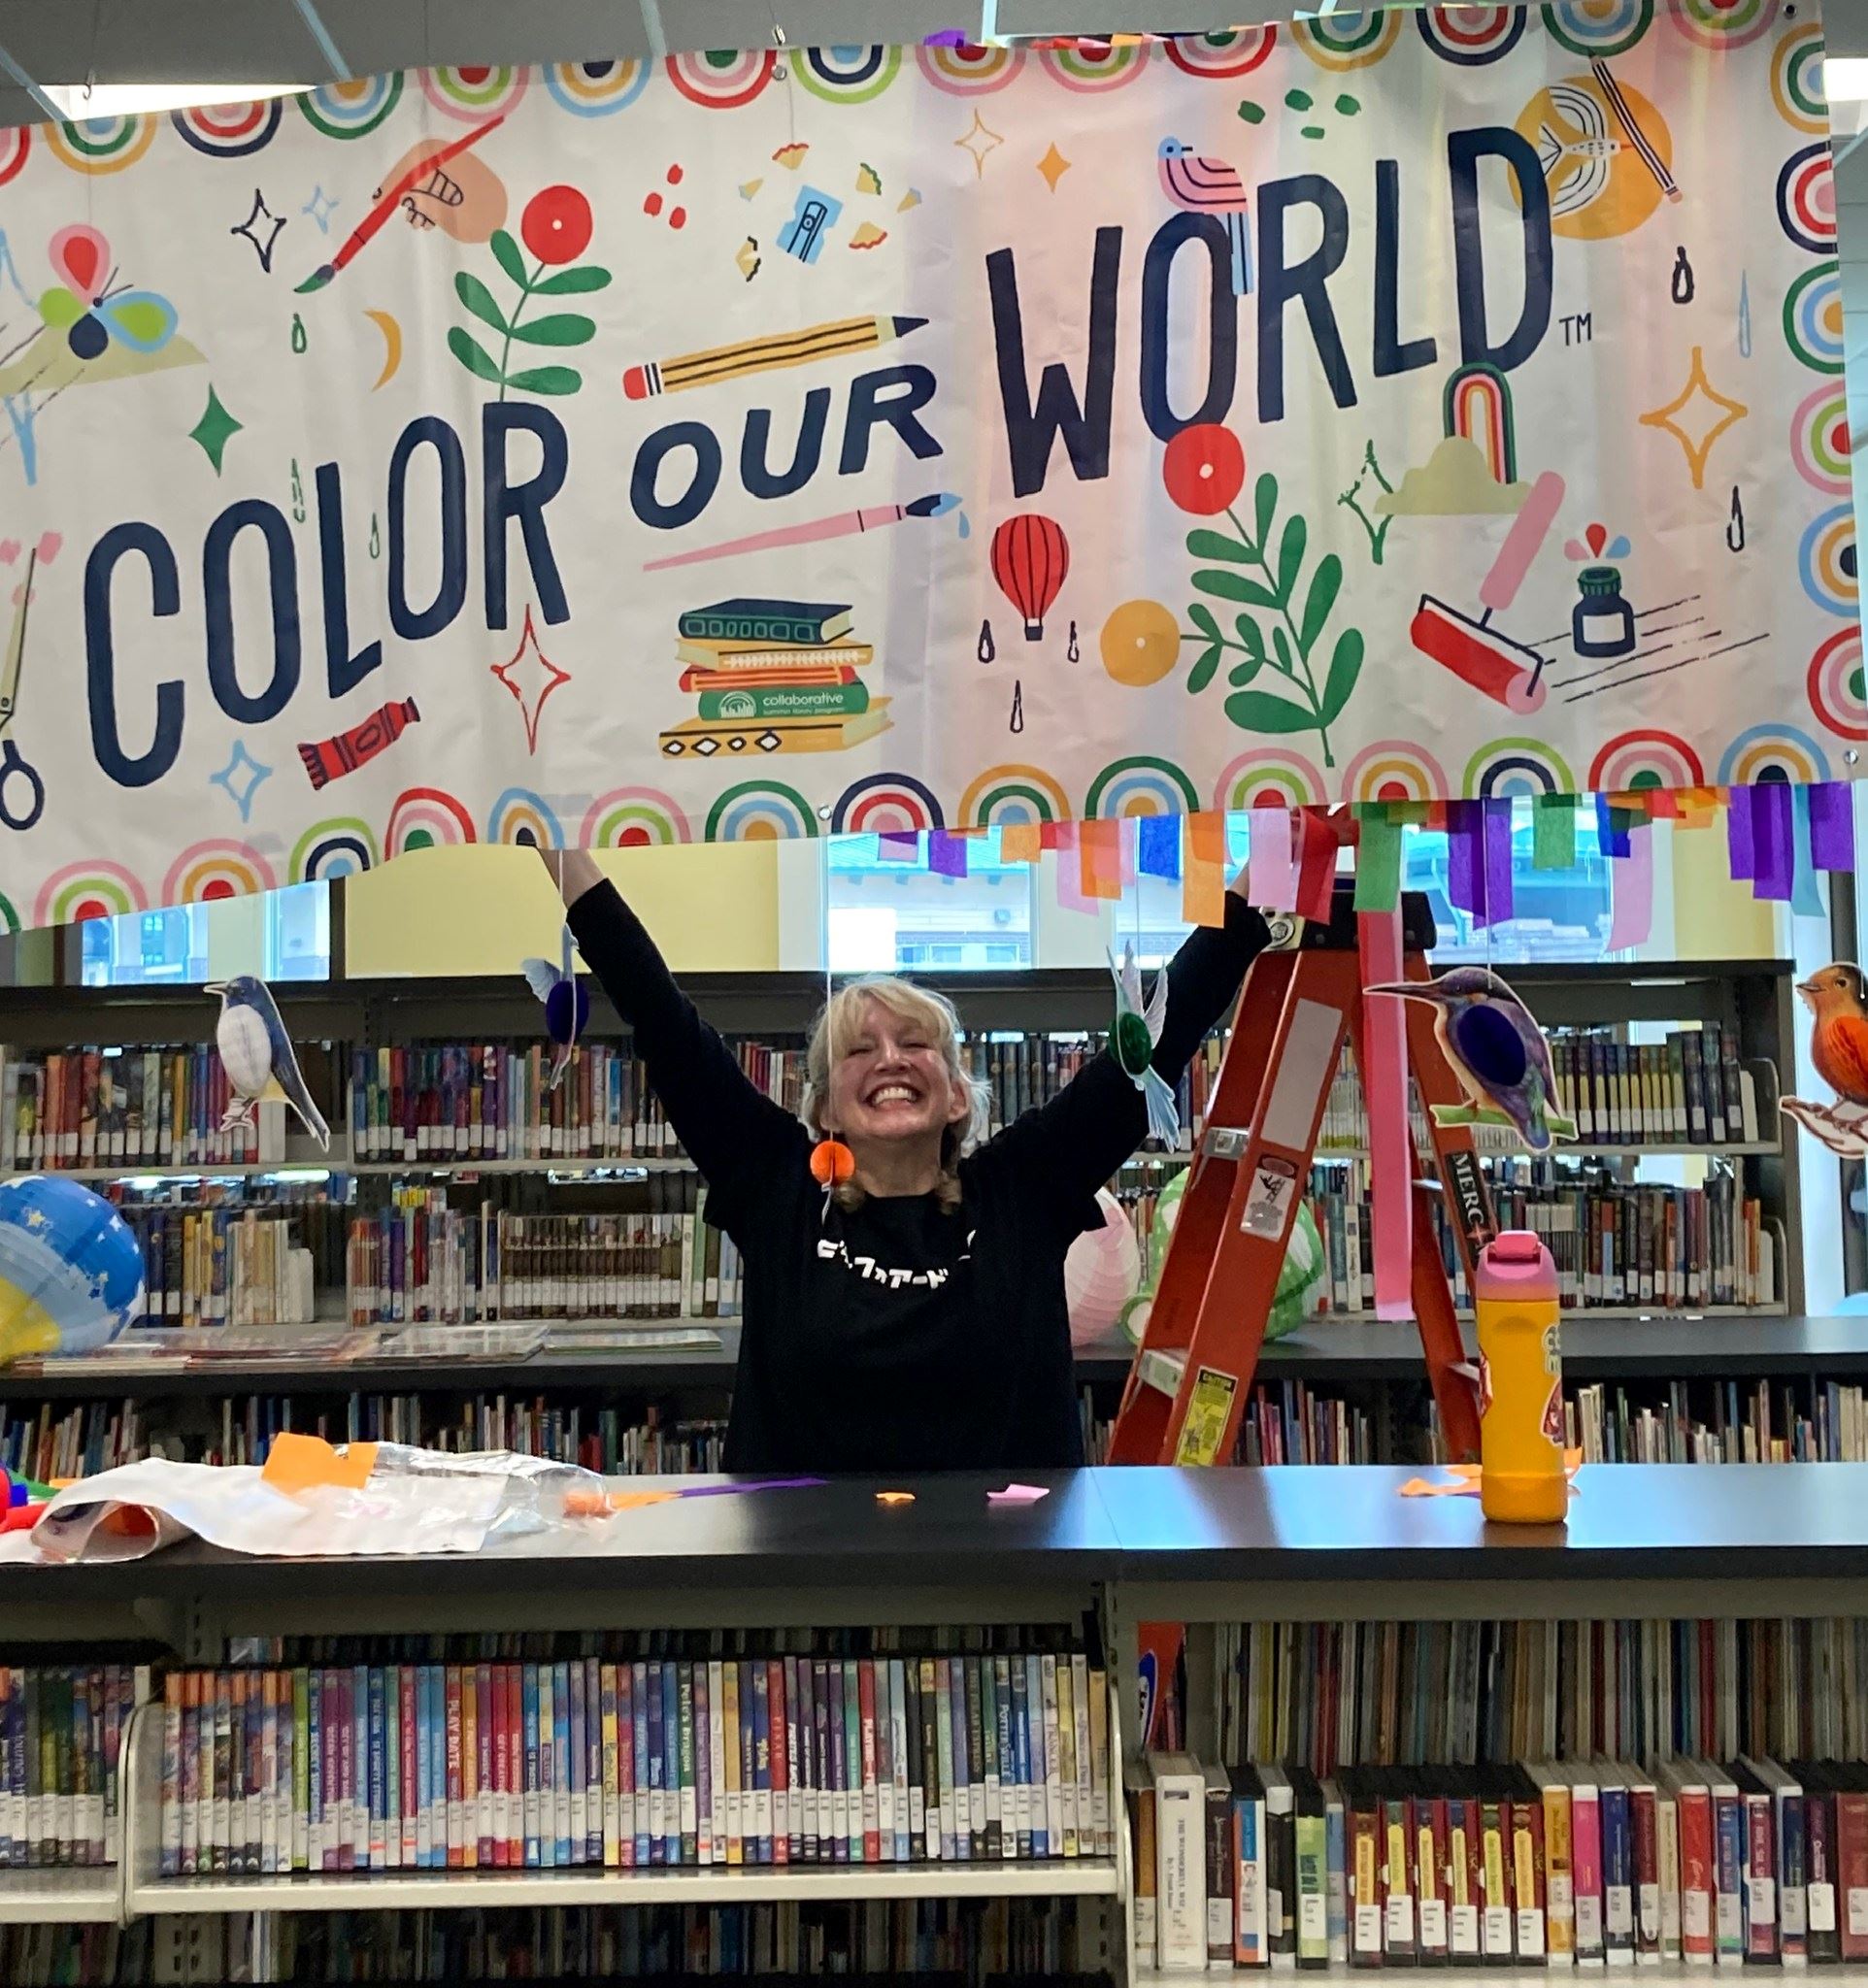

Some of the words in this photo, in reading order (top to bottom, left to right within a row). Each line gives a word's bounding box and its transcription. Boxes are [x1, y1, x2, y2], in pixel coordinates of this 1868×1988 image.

[84, 402, 570, 787] COLOR
[630, 364, 944, 529] OUR
[986, 127, 1553, 498] WORLD
[762, 692, 844, 707] collaborative
[449, 1699, 460, 1733] PLAY
[449, 1736, 460, 1770] DATE
